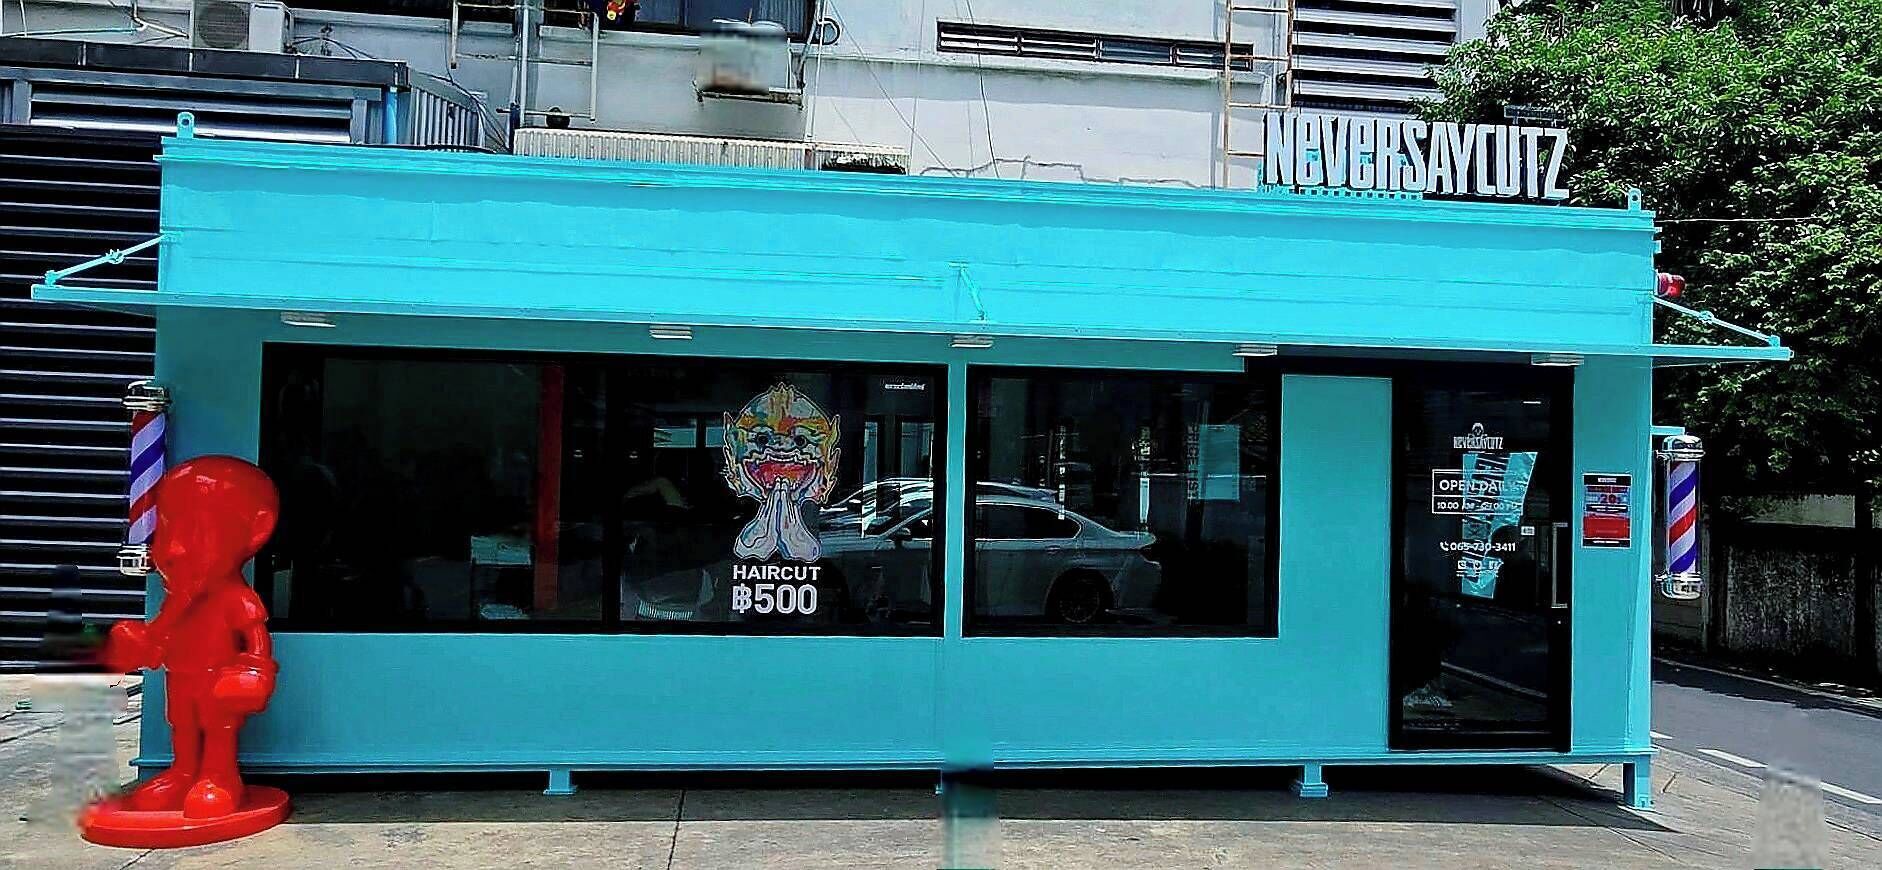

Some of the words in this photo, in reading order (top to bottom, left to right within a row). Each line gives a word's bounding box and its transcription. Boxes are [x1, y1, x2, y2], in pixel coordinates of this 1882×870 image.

[1439, 479, 1479, 491] OPEN
[1450, 542, 1516, 551] 065-730-3411
[732, 564, 821, 581] HAIRCUT
[732, 583, 817, 614] ฿500
